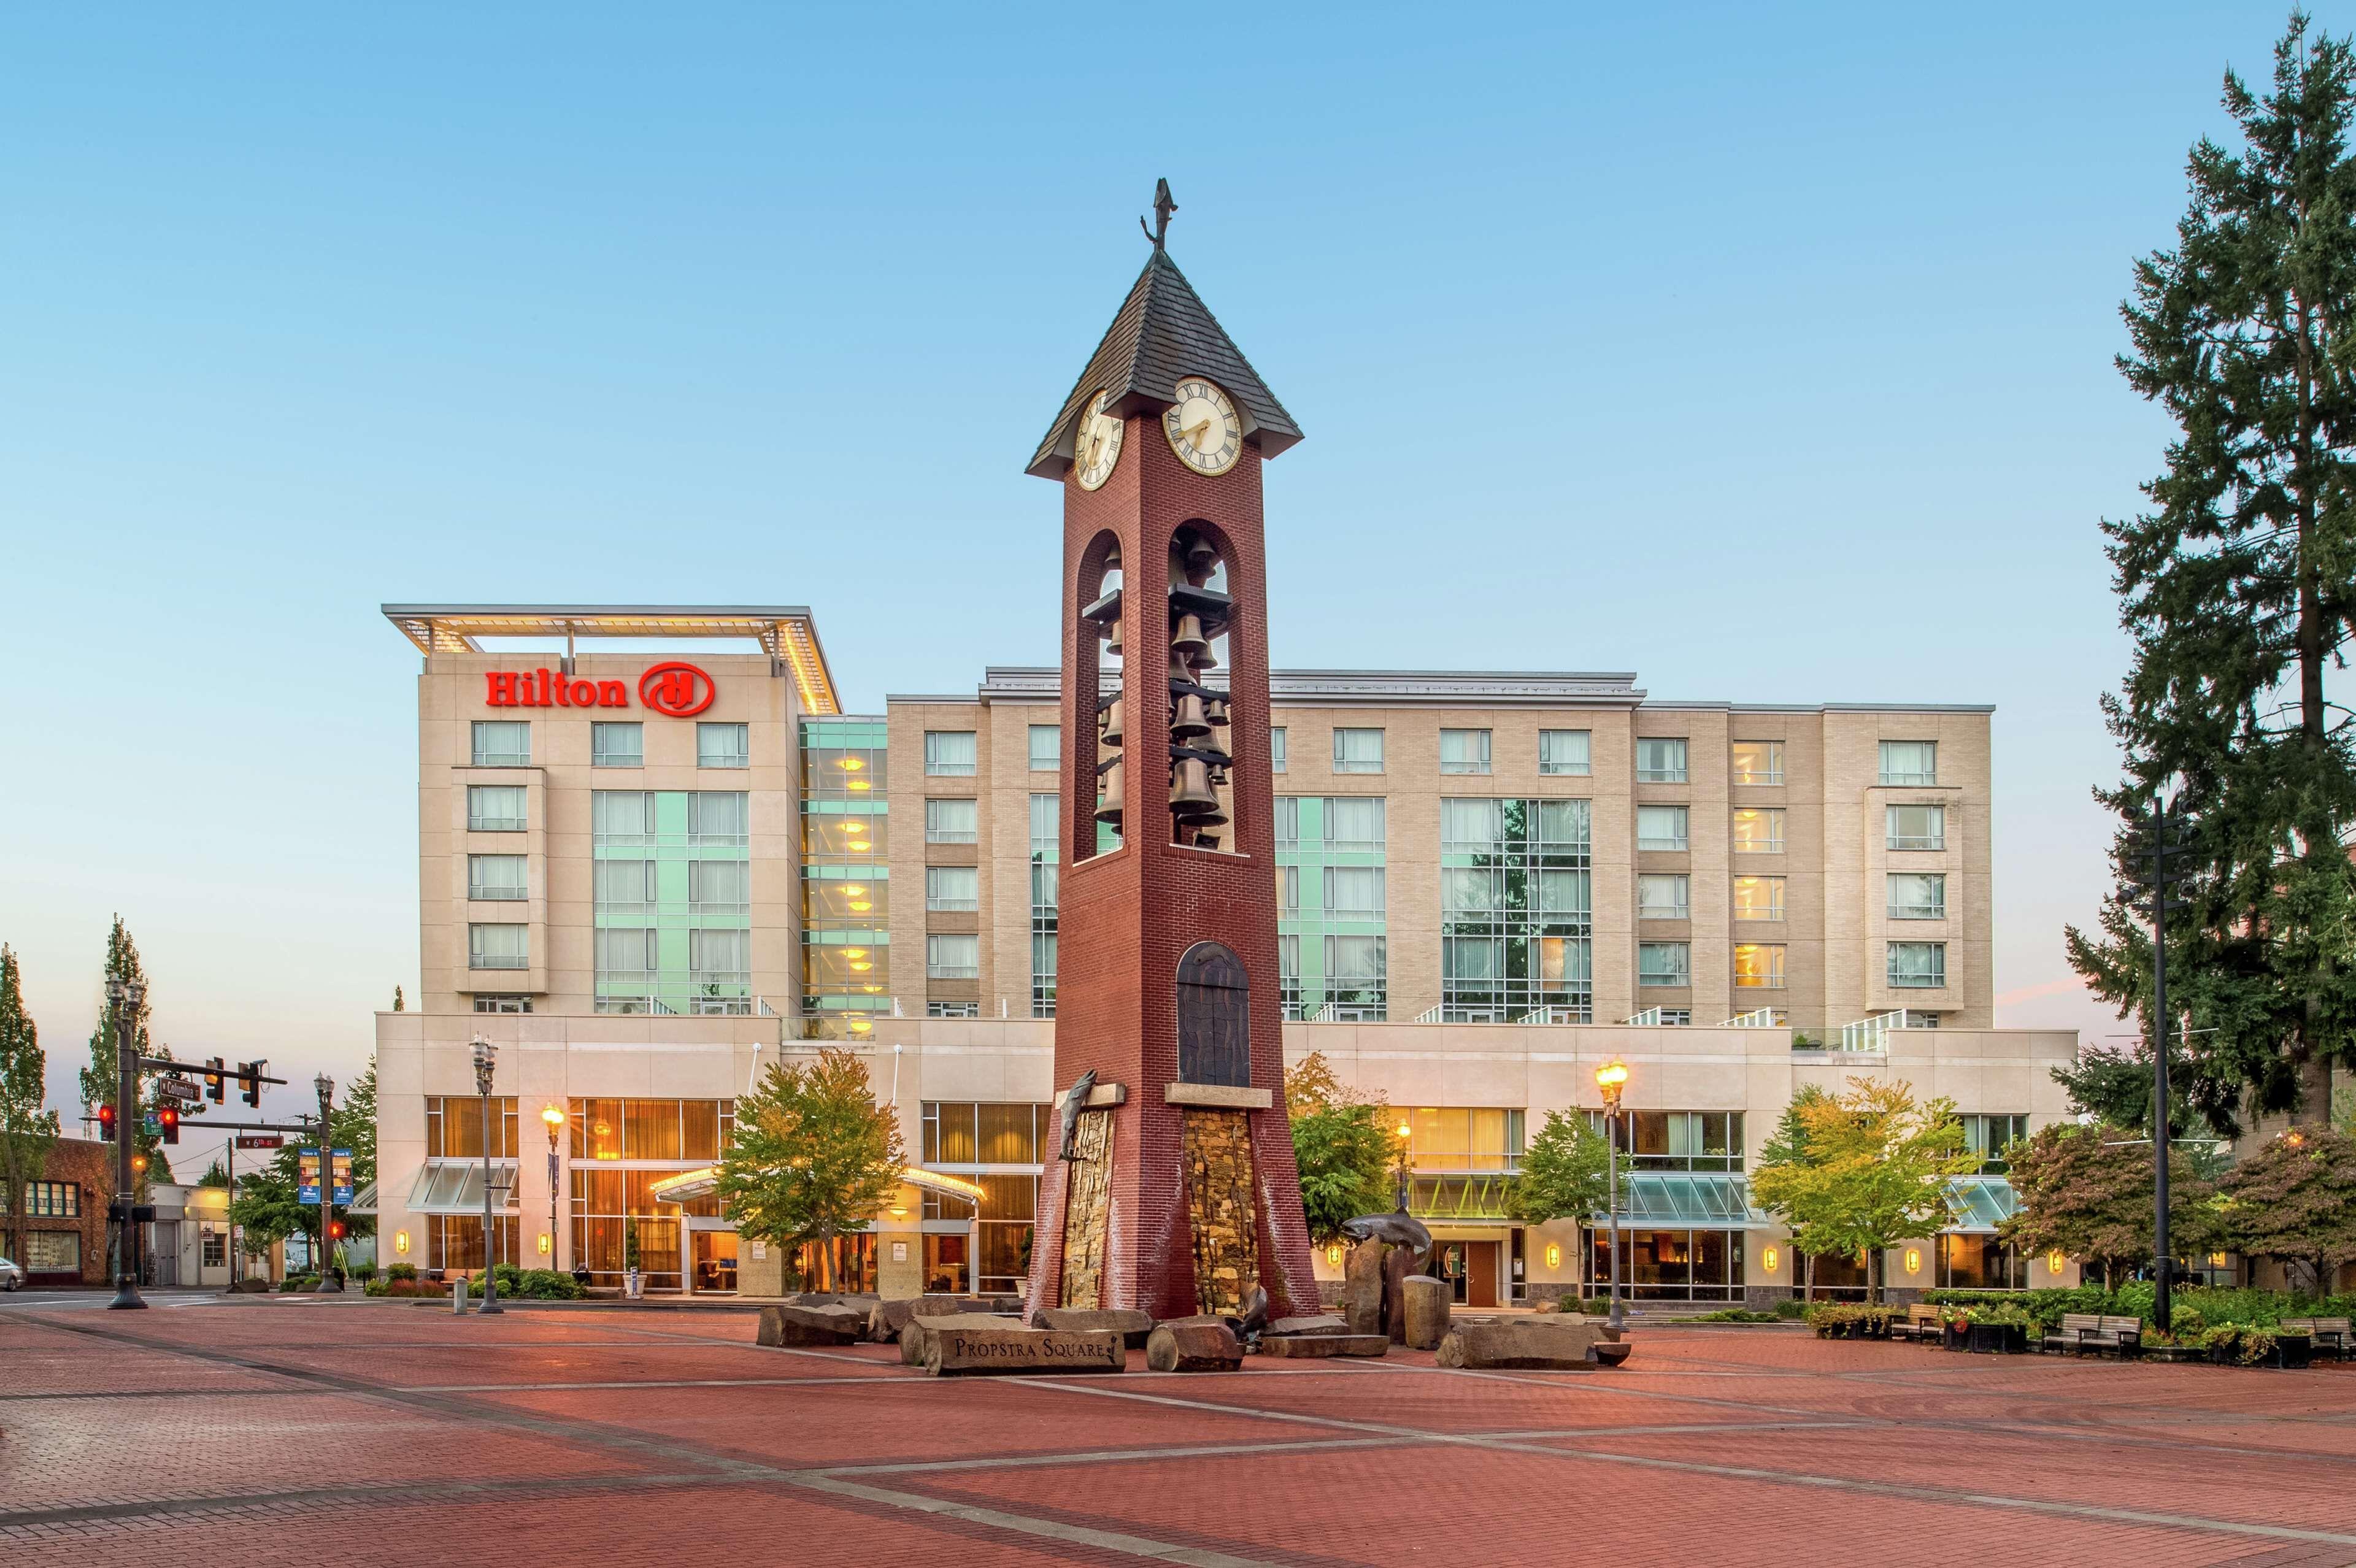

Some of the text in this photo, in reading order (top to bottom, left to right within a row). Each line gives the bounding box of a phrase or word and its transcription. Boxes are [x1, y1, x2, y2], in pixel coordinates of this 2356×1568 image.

[1198, 384, 1208, 399] XII
[486, 668, 628, 707] Hilton
[167, 1081, 194, 1098] Columbia
[253, 1139, 264, 1147] 6th
[955, 1339, 1104, 1358] PROPSTRA SQUARE
